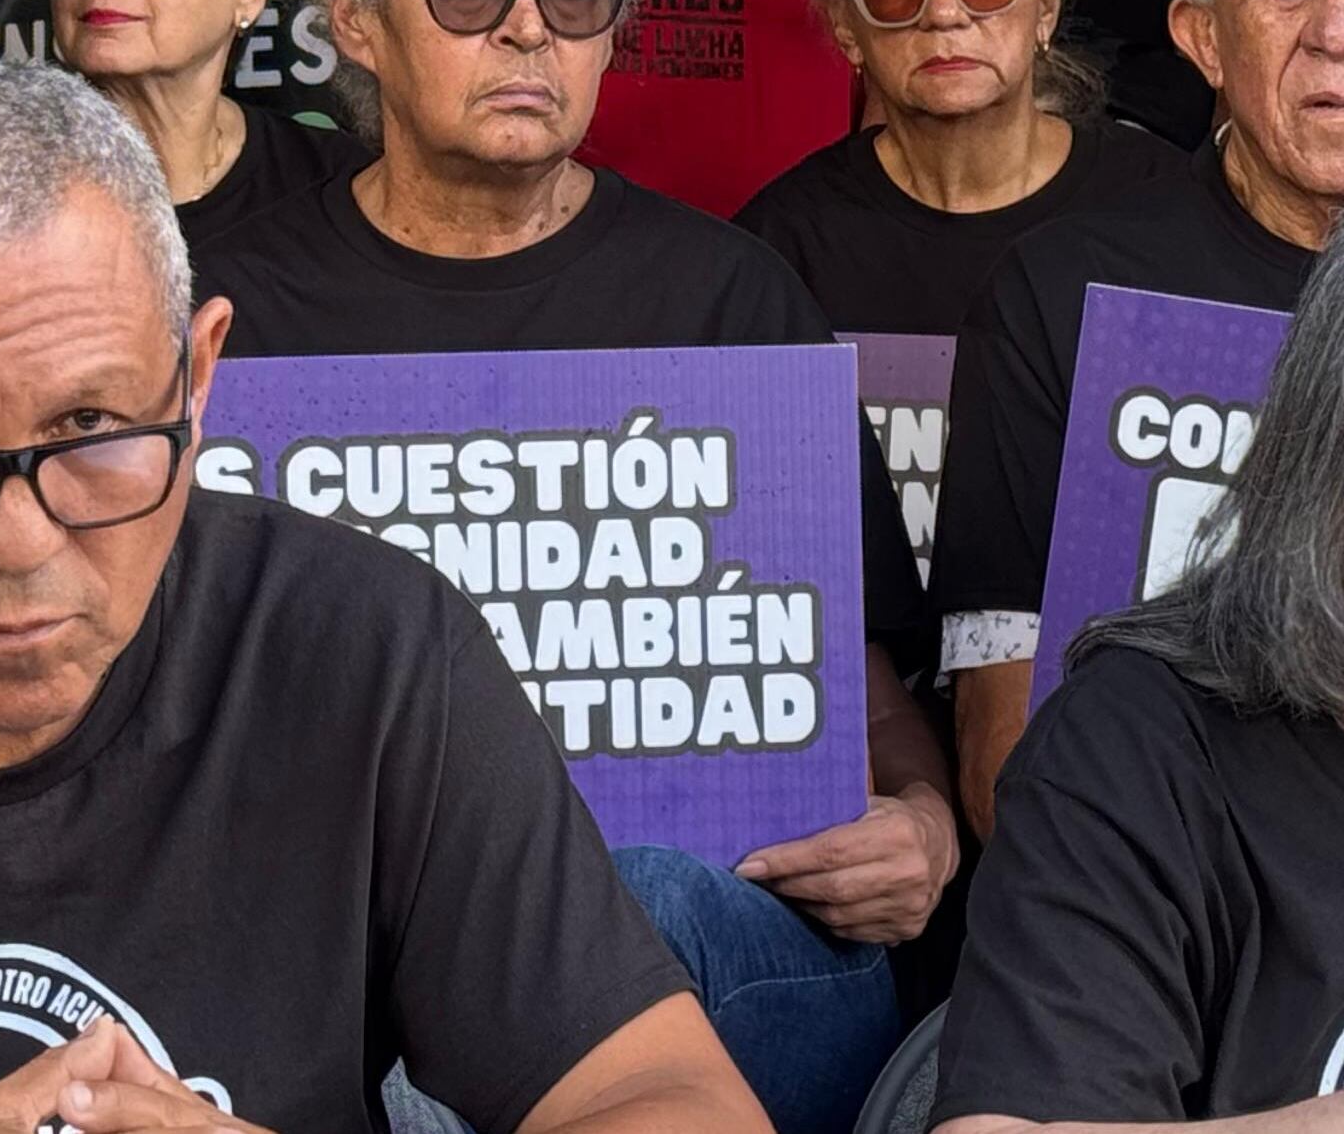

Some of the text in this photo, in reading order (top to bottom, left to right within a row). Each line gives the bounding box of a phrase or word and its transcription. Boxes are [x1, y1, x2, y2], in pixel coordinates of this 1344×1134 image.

[287, 416, 728, 519] CUESTIÓN
[484, 571, 814, 671] AMBIÉN
[523, 673, 816, 752] TIDAD
